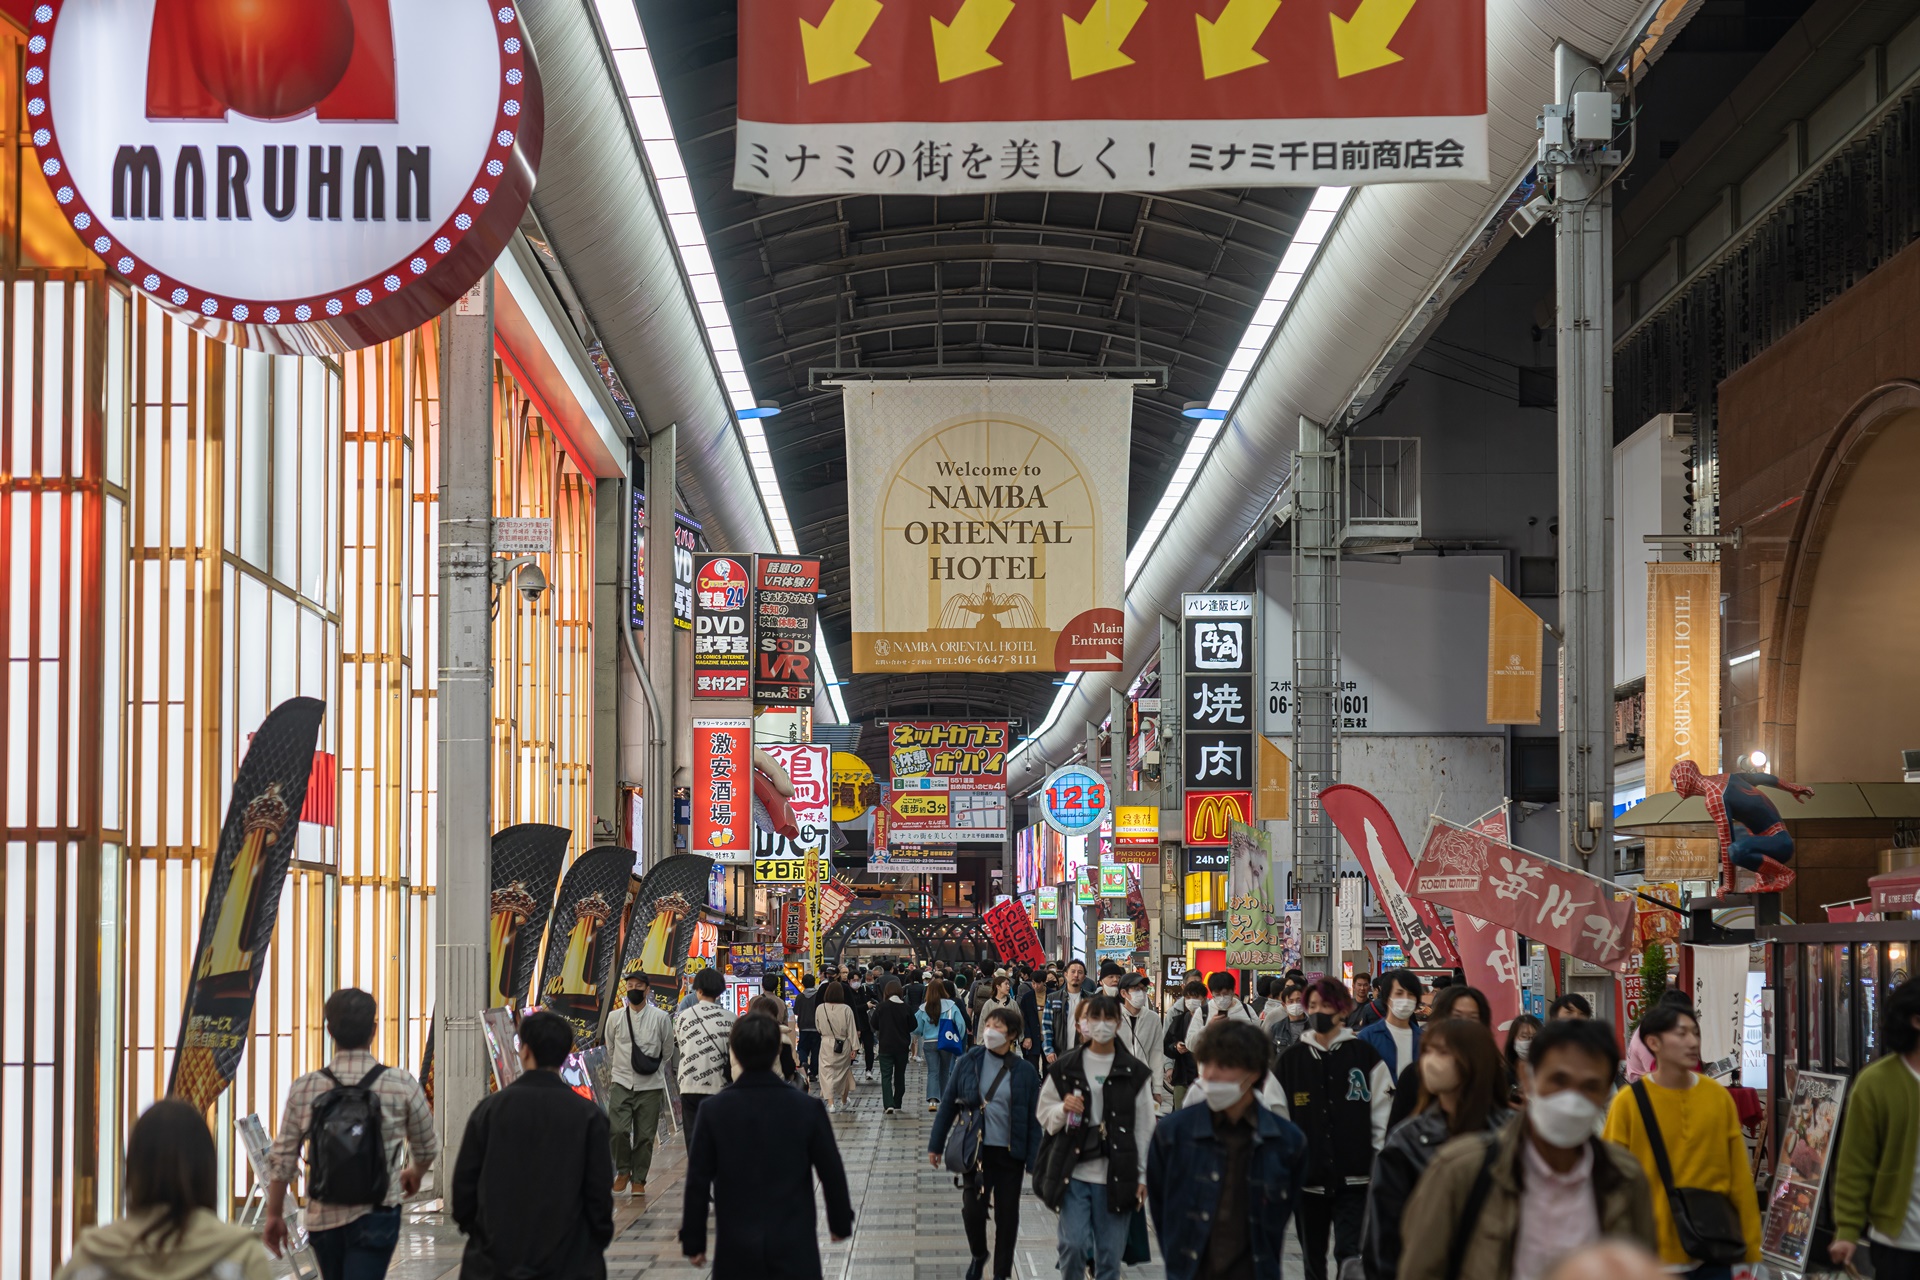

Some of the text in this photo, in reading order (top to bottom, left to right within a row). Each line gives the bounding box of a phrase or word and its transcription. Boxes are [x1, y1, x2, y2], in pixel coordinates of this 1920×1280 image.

[1189, 138, 1465, 171] ミナミ千日前商店会
[111, 144, 432, 222] MARUHAN
[936, 461, 1041, 477] Welcome to
[927, 484, 1048, 509] NAMBA
[904, 520, 1073, 546] ORIENTAL
[767, 562, 802, 574] 話題の
[930, 556, 1046, 580] HOTEL
[699, 587, 745, 607] 宝島24
[759, 605, 789, 615] 未知の
[1188, 599, 1250, 612] パレ逢阪ビル
[696, 616, 745, 634] DVD
[1093, 622, 1123, 634] Main
[1675, 589, 1691, 651] HOTEL
[695, 636, 749, 653] 試写室
[761, 638, 811, 653] SOD
[893, 641, 1036, 652] NAMBA ORIENTAL HOTEL
[1071, 635, 1123, 646] Entrance
[1201, 630, 1238, 659] 牛角
[760, 653, 810, 680] VR
[936, 655, 1037, 665] TEL:06-6647-8111
[697, 677, 746, 690] 受付2F
[1674, 653, 1691, 746] ORIENTAL
[892, 724, 1004, 747] ネットカフェ
[933, 748, 1006, 775] ポパイ
[710, 732, 732, 826] 激安酒場
[1045, 784, 1106, 809] 123
[900, 801, 947, 813] 徒歩約3分
[1195, 855, 1214, 864] 24h
[1100, 923, 1133, 935] 北海道
[1229, 914, 1252, 928] もう
[1104, 935, 1127, 946] 酒場
[732, 945, 764, 956] 超進化
[682, 1017, 704, 1032] CLOUD
